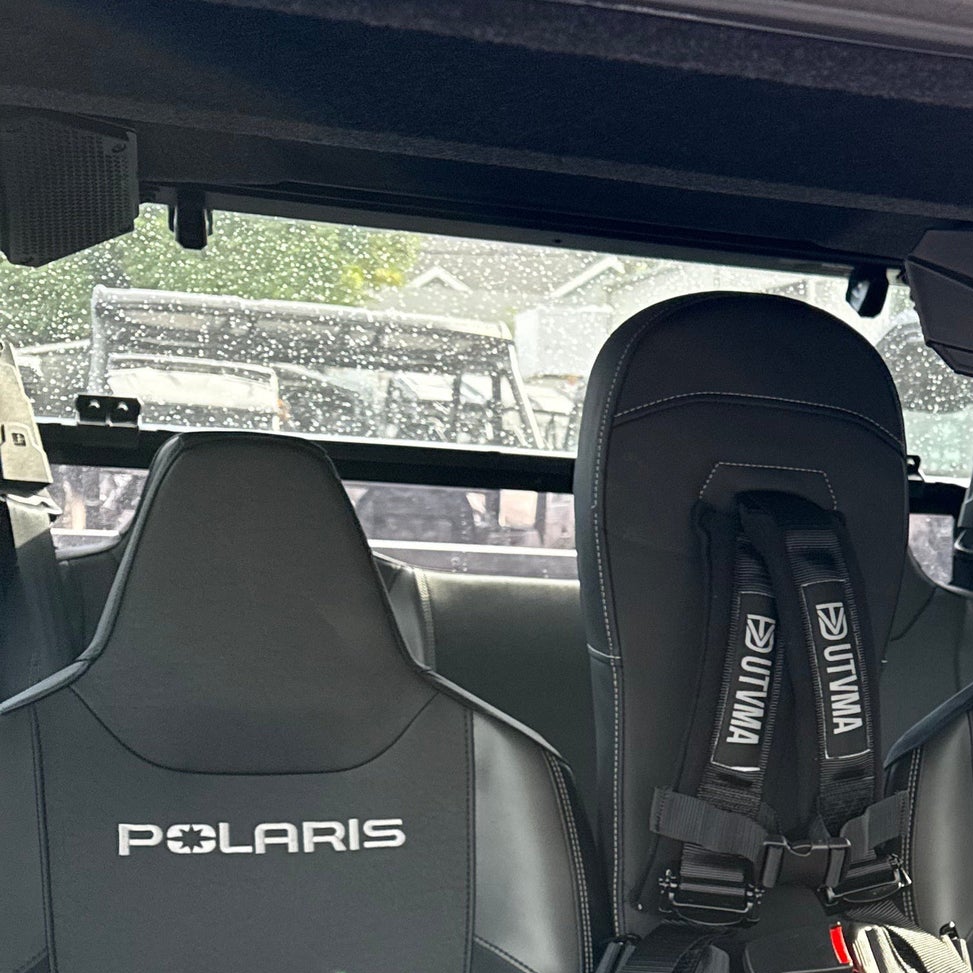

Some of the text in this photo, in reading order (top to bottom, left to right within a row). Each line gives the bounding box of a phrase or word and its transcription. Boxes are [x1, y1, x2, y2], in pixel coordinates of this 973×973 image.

[726, 655, 773, 744] UTVMA
[823, 643, 863, 735] UTVMA
[118, 818, 406, 856] POLARIS
